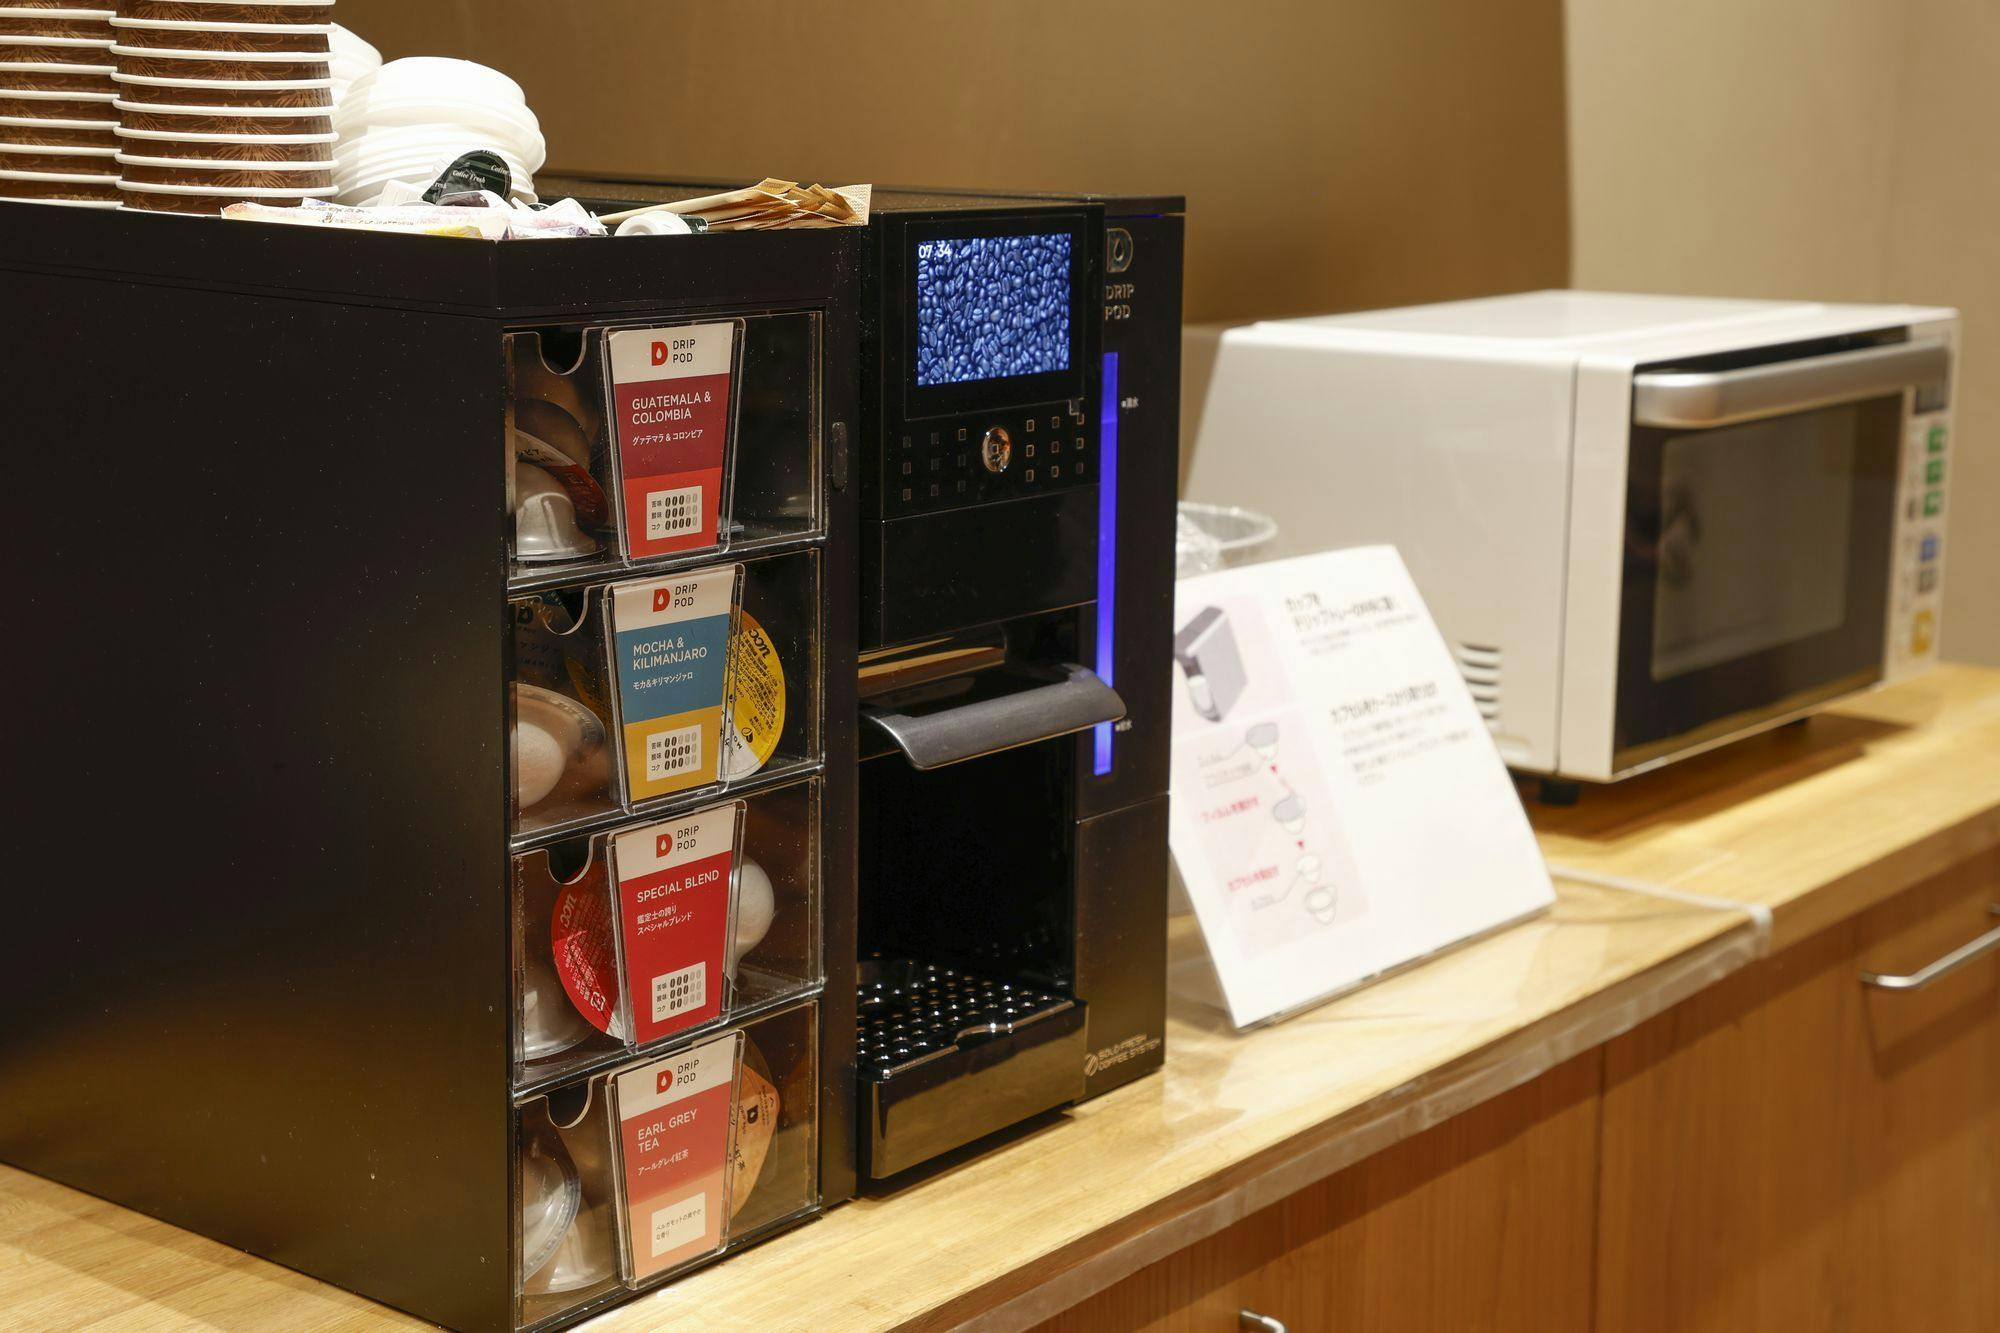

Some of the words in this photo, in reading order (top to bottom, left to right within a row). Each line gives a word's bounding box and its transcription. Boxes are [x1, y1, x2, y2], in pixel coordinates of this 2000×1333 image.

[918, 242, 953, 260] 07:34
[1105, 283, 1135, 300] DRIP
[1104, 304, 1131, 321] POD
[672, 339, 696, 350] DRIP
[672, 352, 693, 364] POD
[632, 392, 702, 411] GUATEMALA
[704, 391, 712, 403] &
[632, 407, 692, 426] COLOMBIA
[675, 583, 698, 596] DRIP
[674, 596, 694, 609] POD
[633, 639, 674, 657] MOCHA
[677, 637, 684, 648] &
[633, 646, 708, 671] KILIMANJARO
[677, 825, 700, 839] DRIP
[677, 838, 697, 852] POD
[637, 881, 682, 903] SPECIAL
[685, 869, 720, 889] BLEND
[637, 911, 692, 936] スペシャルブレンド
[677, 1059, 700, 1074] DRIP
[677, 1072, 696, 1087] POD
[638, 1121, 667, 1141] EARL
[668, 1108, 698, 1129] GREY
[638, 1137, 660, 1154] TEA
